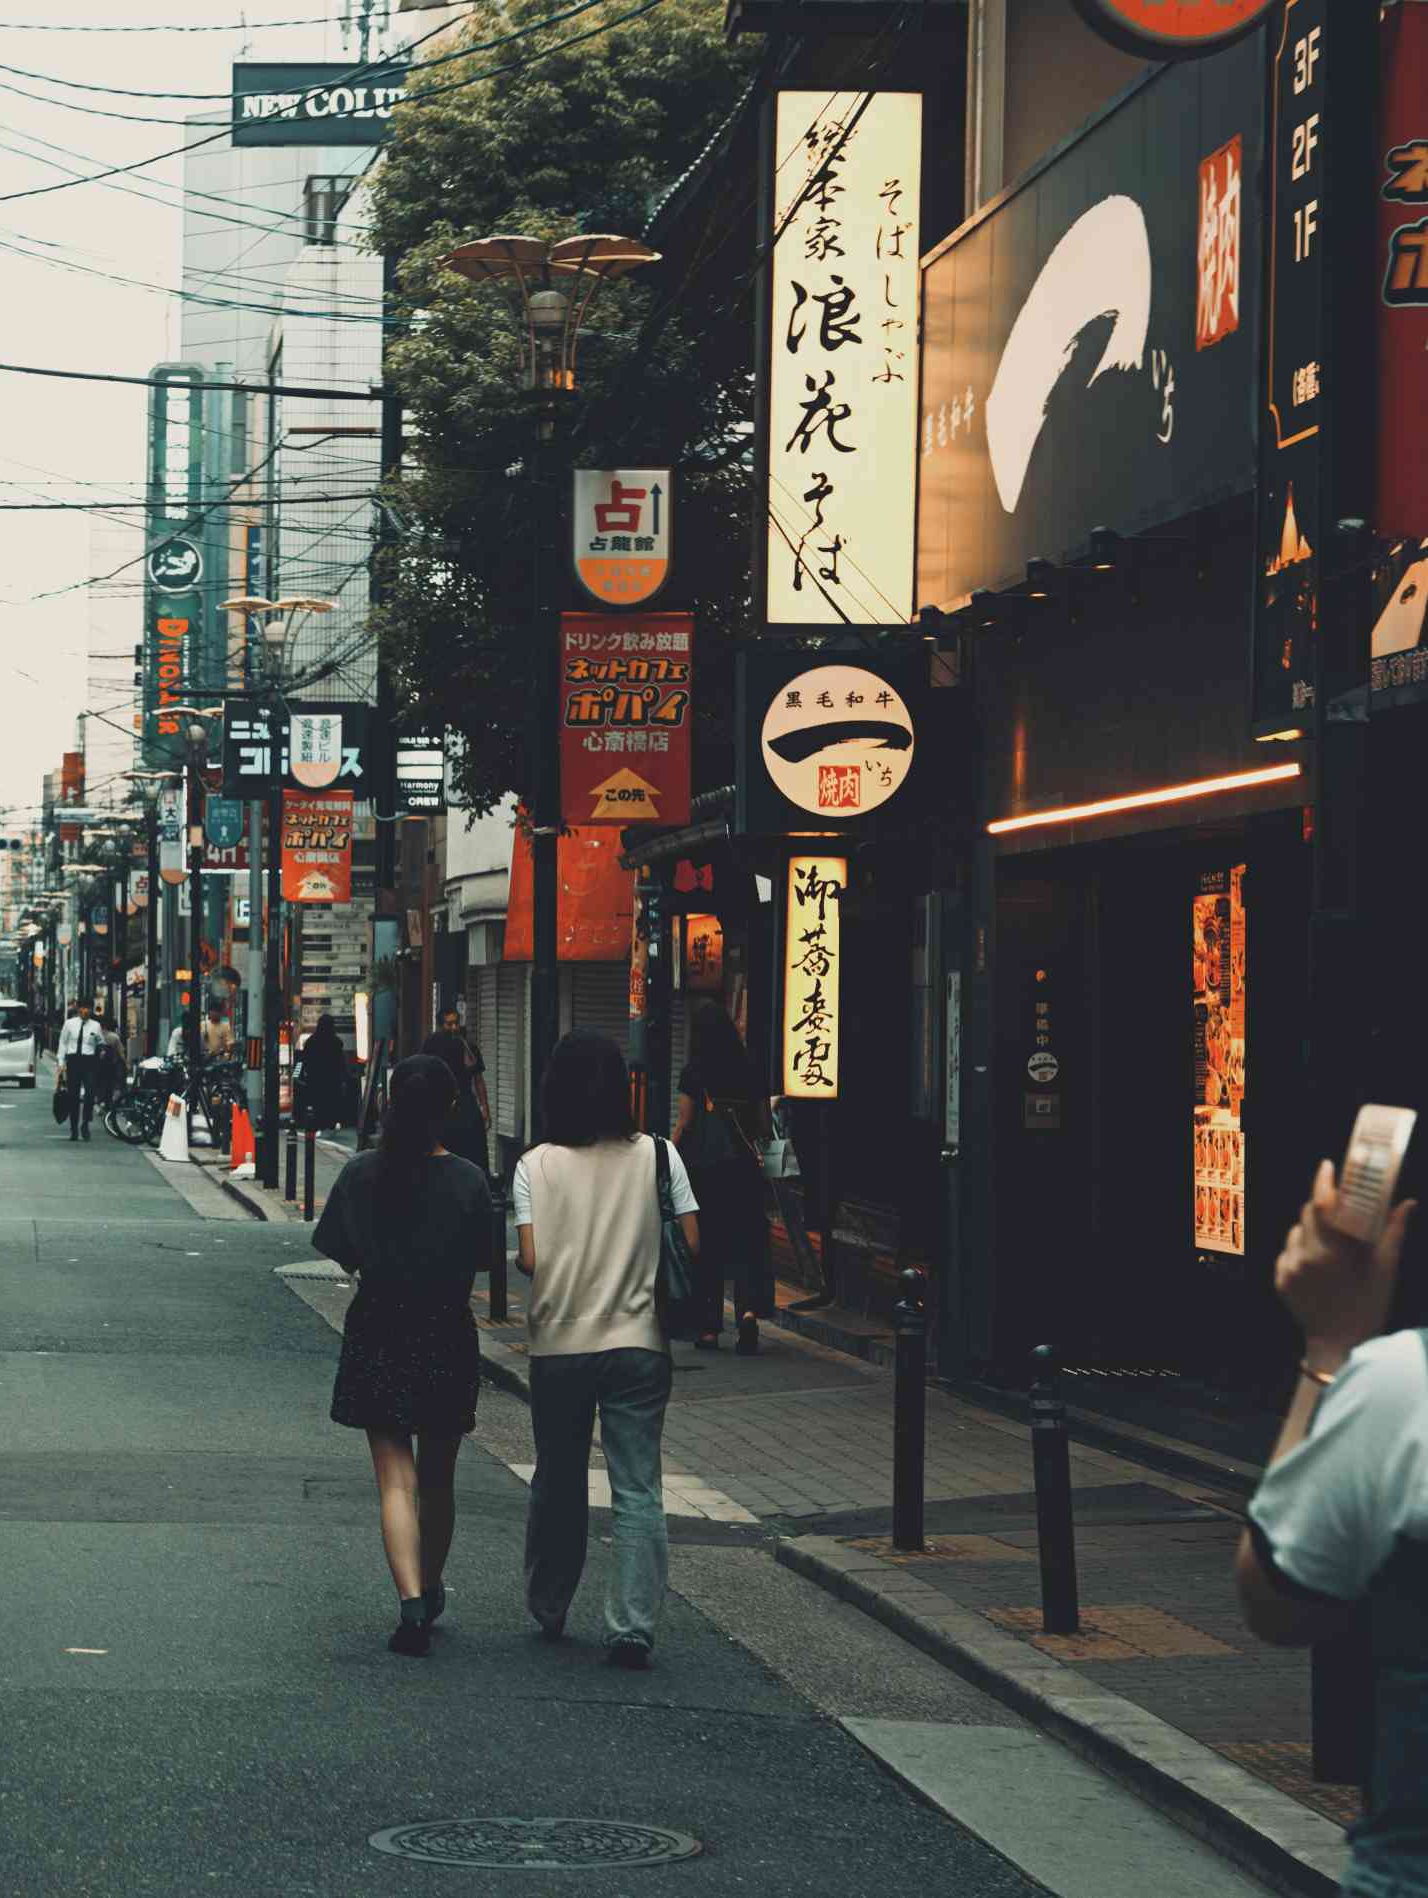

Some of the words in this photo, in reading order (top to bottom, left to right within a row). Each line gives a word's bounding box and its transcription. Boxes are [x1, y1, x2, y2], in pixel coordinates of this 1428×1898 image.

[1293, 26, 1321, 95] 3F
[241, 94, 302, 118] NEW
[1291, 113, 1320, 182] 2F
[1293, 199, 1318, 263] 1F
[594, 479, 647, 533] 占
[564, 632, 690, 651] ドリンク飲み放題
[565, 656, 689, 684] ネットカフェ
[564, 688, 689, 727] ポパイ
[785, 690, 894, 710] 黒毛和牛
[582, 731, 670, 752] 心斎橋店
[864, 758, 893, 788] いち
[603, 787, 646, 802] この先
[818, 768, 859, 808] 焼肉
[284, 828, 351, 849] ポパイ
